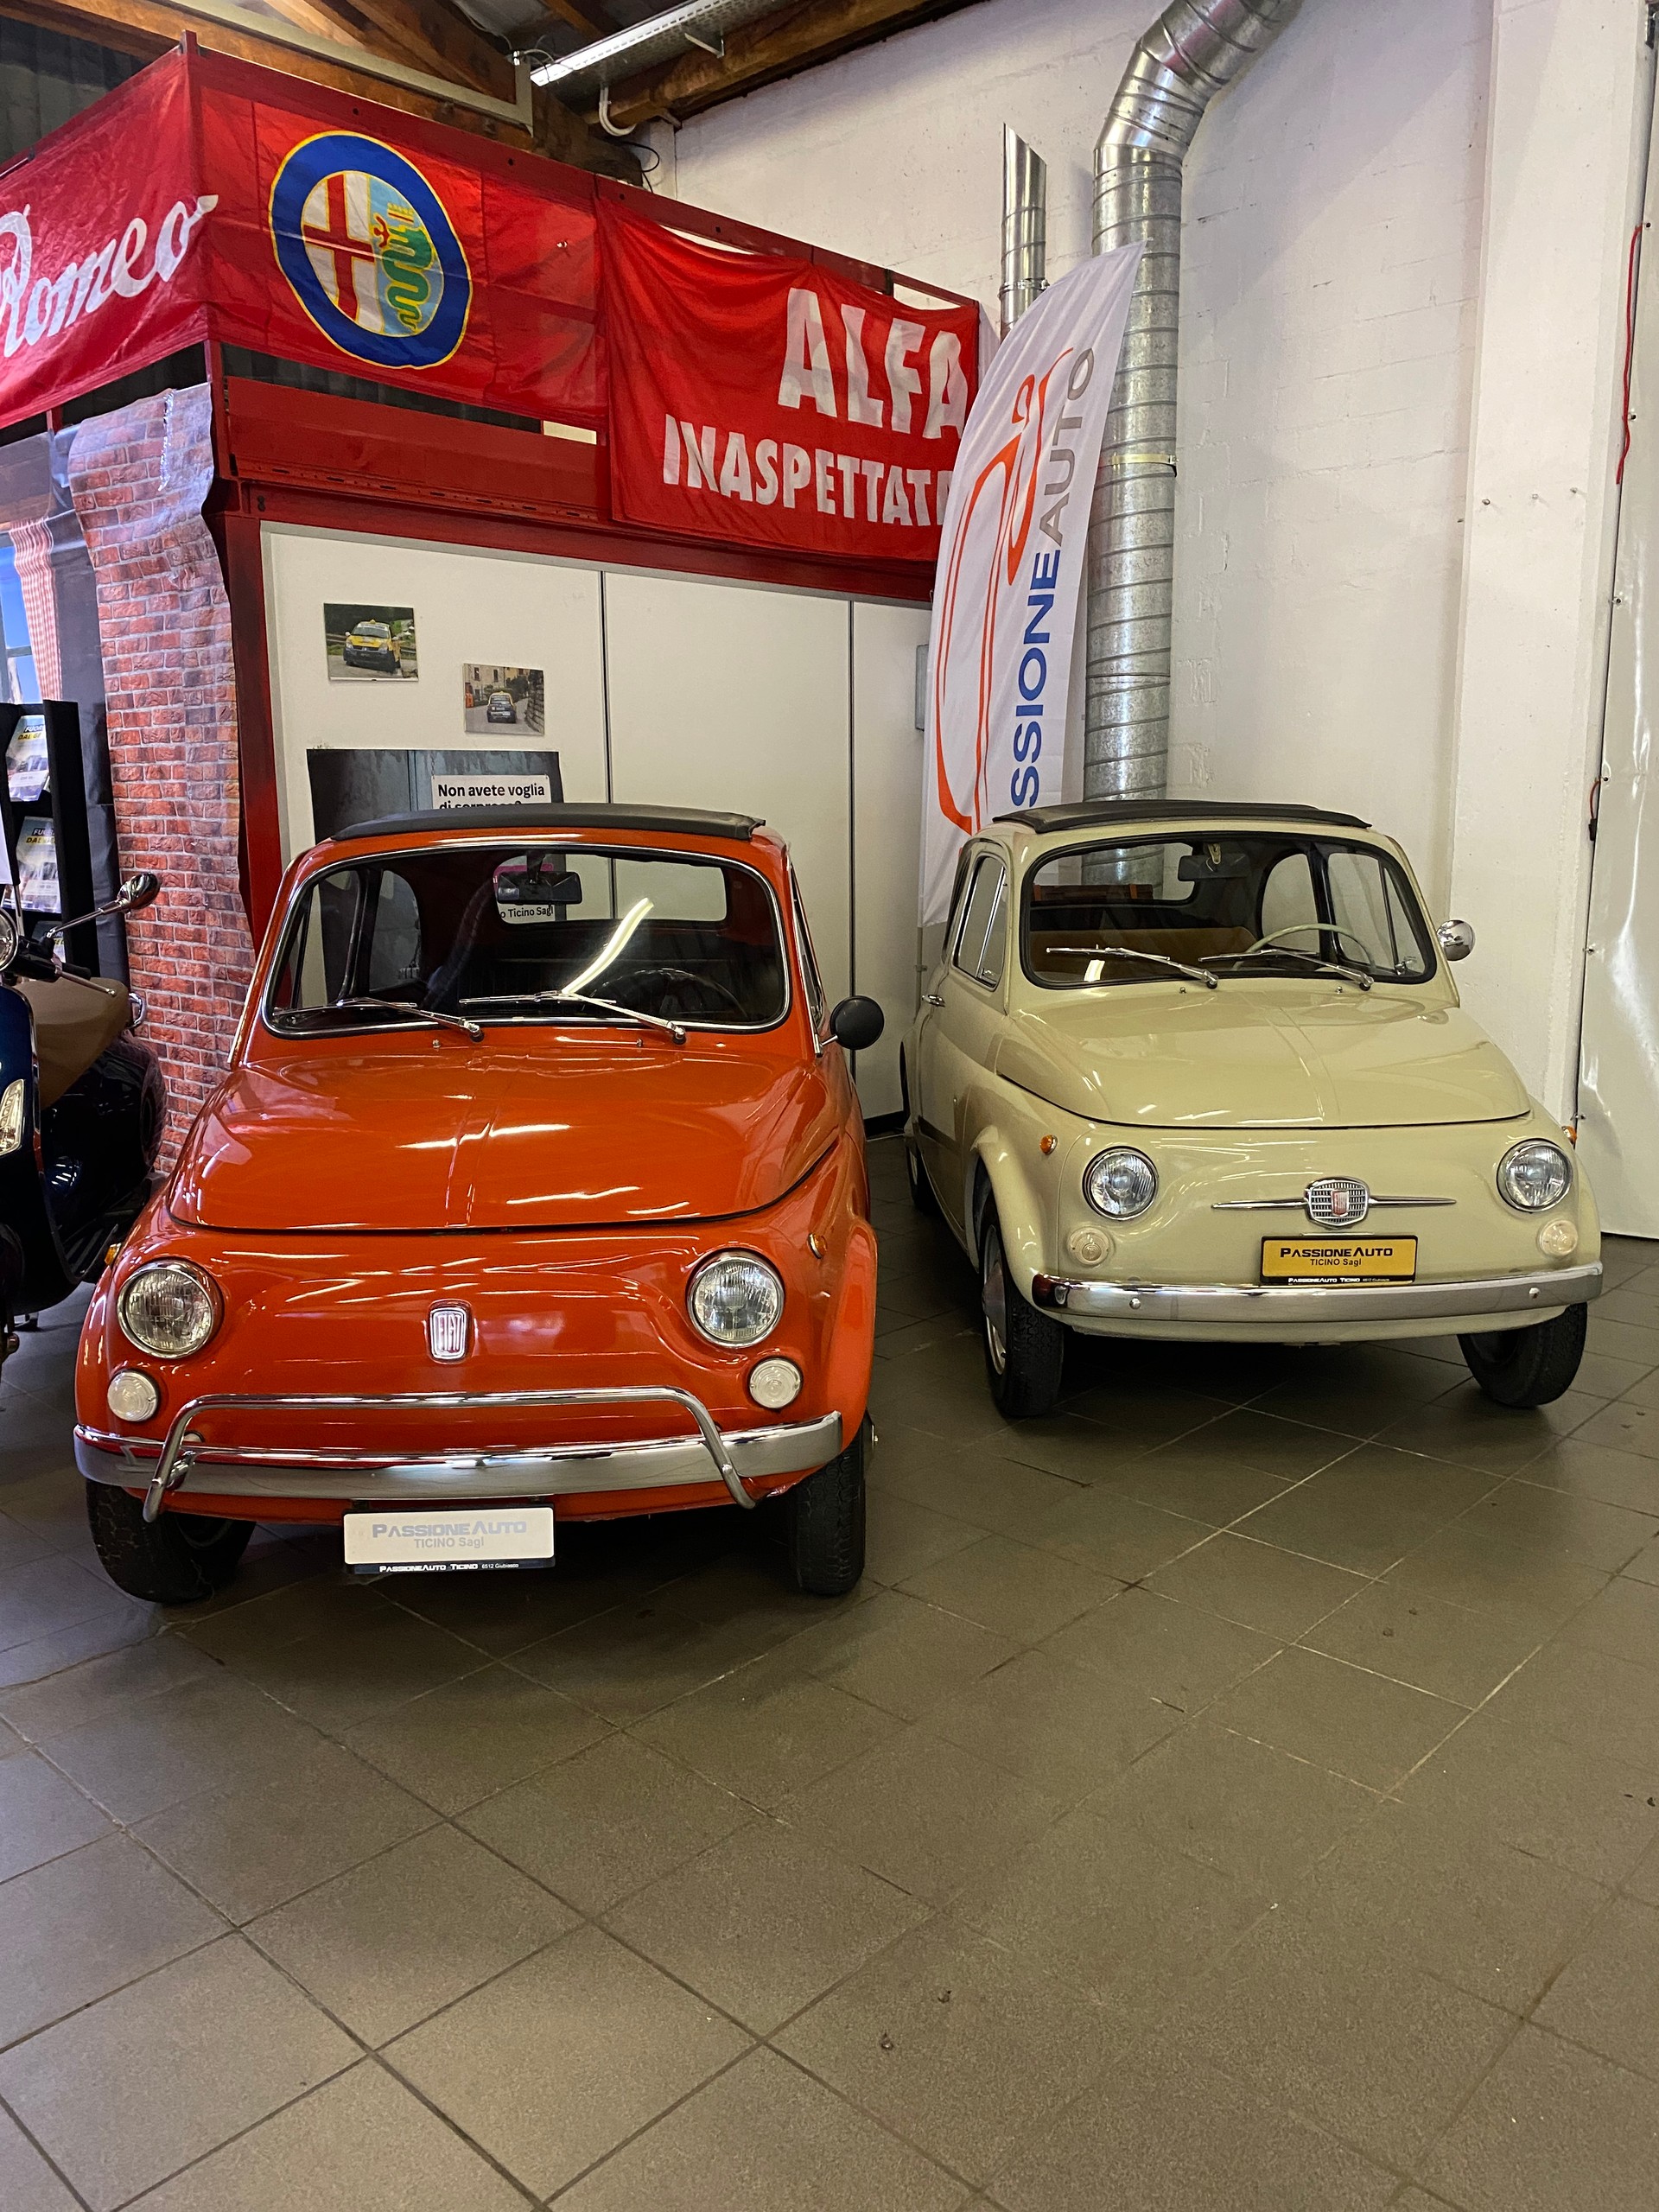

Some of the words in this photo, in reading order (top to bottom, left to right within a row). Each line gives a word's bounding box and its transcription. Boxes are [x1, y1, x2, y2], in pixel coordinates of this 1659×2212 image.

[0, 194, 219, 358] Romeo
[778, 288, 969, 439] ALFA
[438, 784, 465, 797] Non
[468, 785, 505, 796] avete
[508, 783, 545, 798] voglia
[508, 908, 535, 918] Ticino
[537, 906, 554, 917] Sagl
[1343, 1258, 1362, 1267] Sagl
[437, 1313, 461, 1351] FIAT
[414, 1537, 455, 1548] TICINO
[459, 1536, 484, 1548] Sagl
